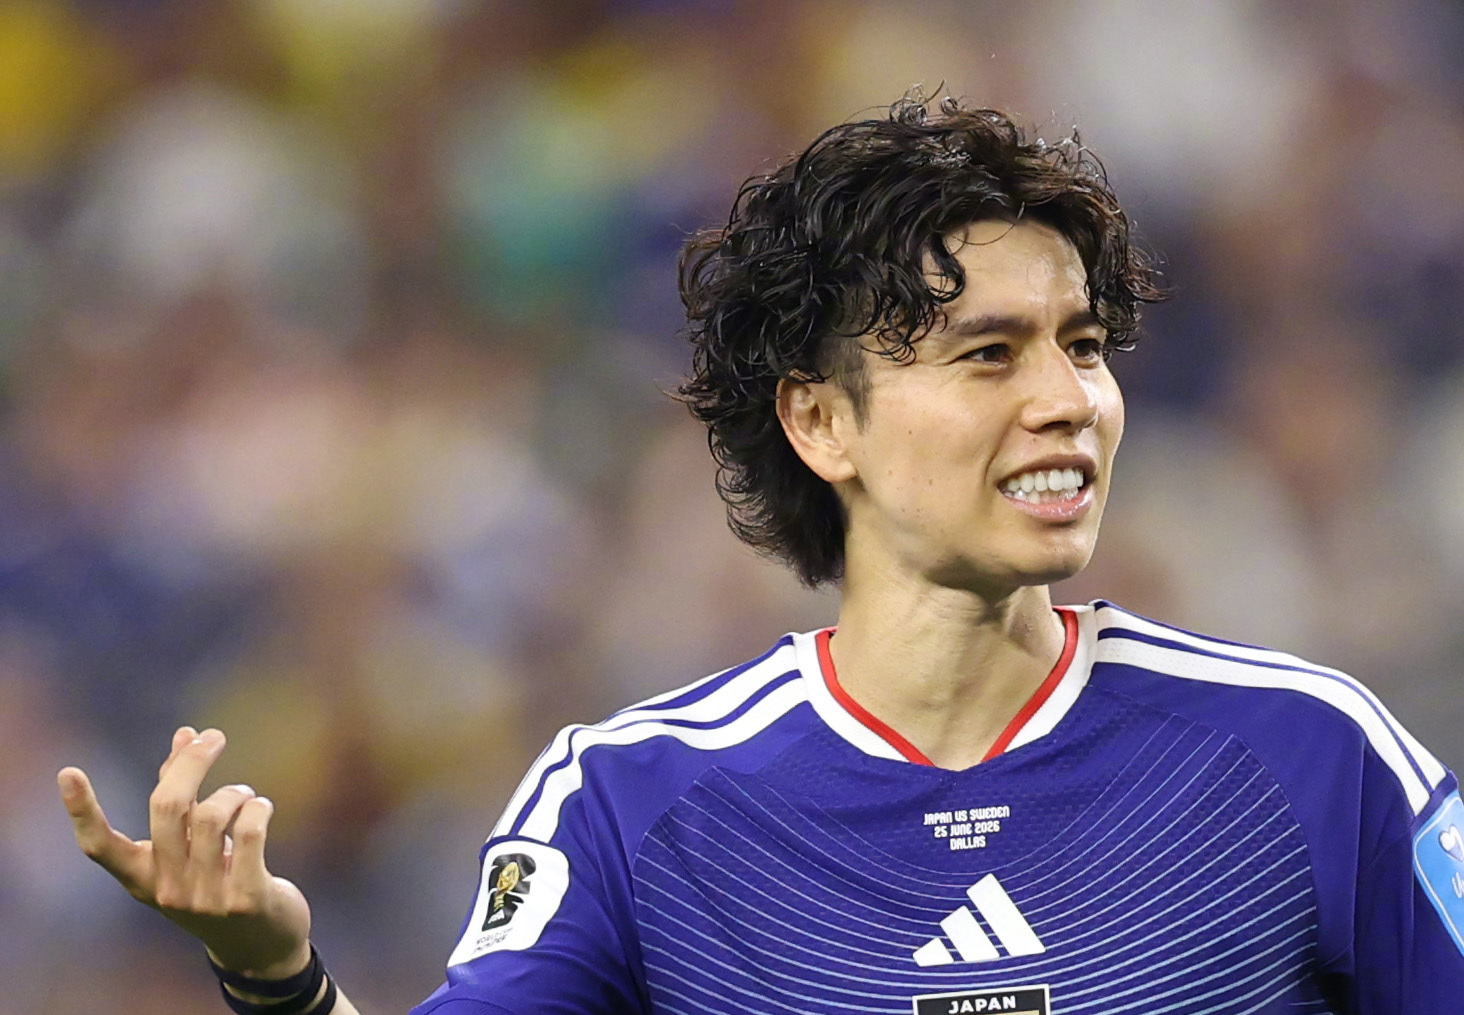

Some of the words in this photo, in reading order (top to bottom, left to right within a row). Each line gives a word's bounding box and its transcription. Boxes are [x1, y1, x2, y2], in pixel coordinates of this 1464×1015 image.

[923, 812, 953, 825] JAPAN
[969, 806, 1010, 821] SWEDEN
[934, 826, 948, 838] 25
[950, 823, 973, 837] JUNE
[974, 820, 1000, 834] 2026
[949, 835, 986, 850] DALLAS
[948, 996, 1016, 1014] JAPAN
